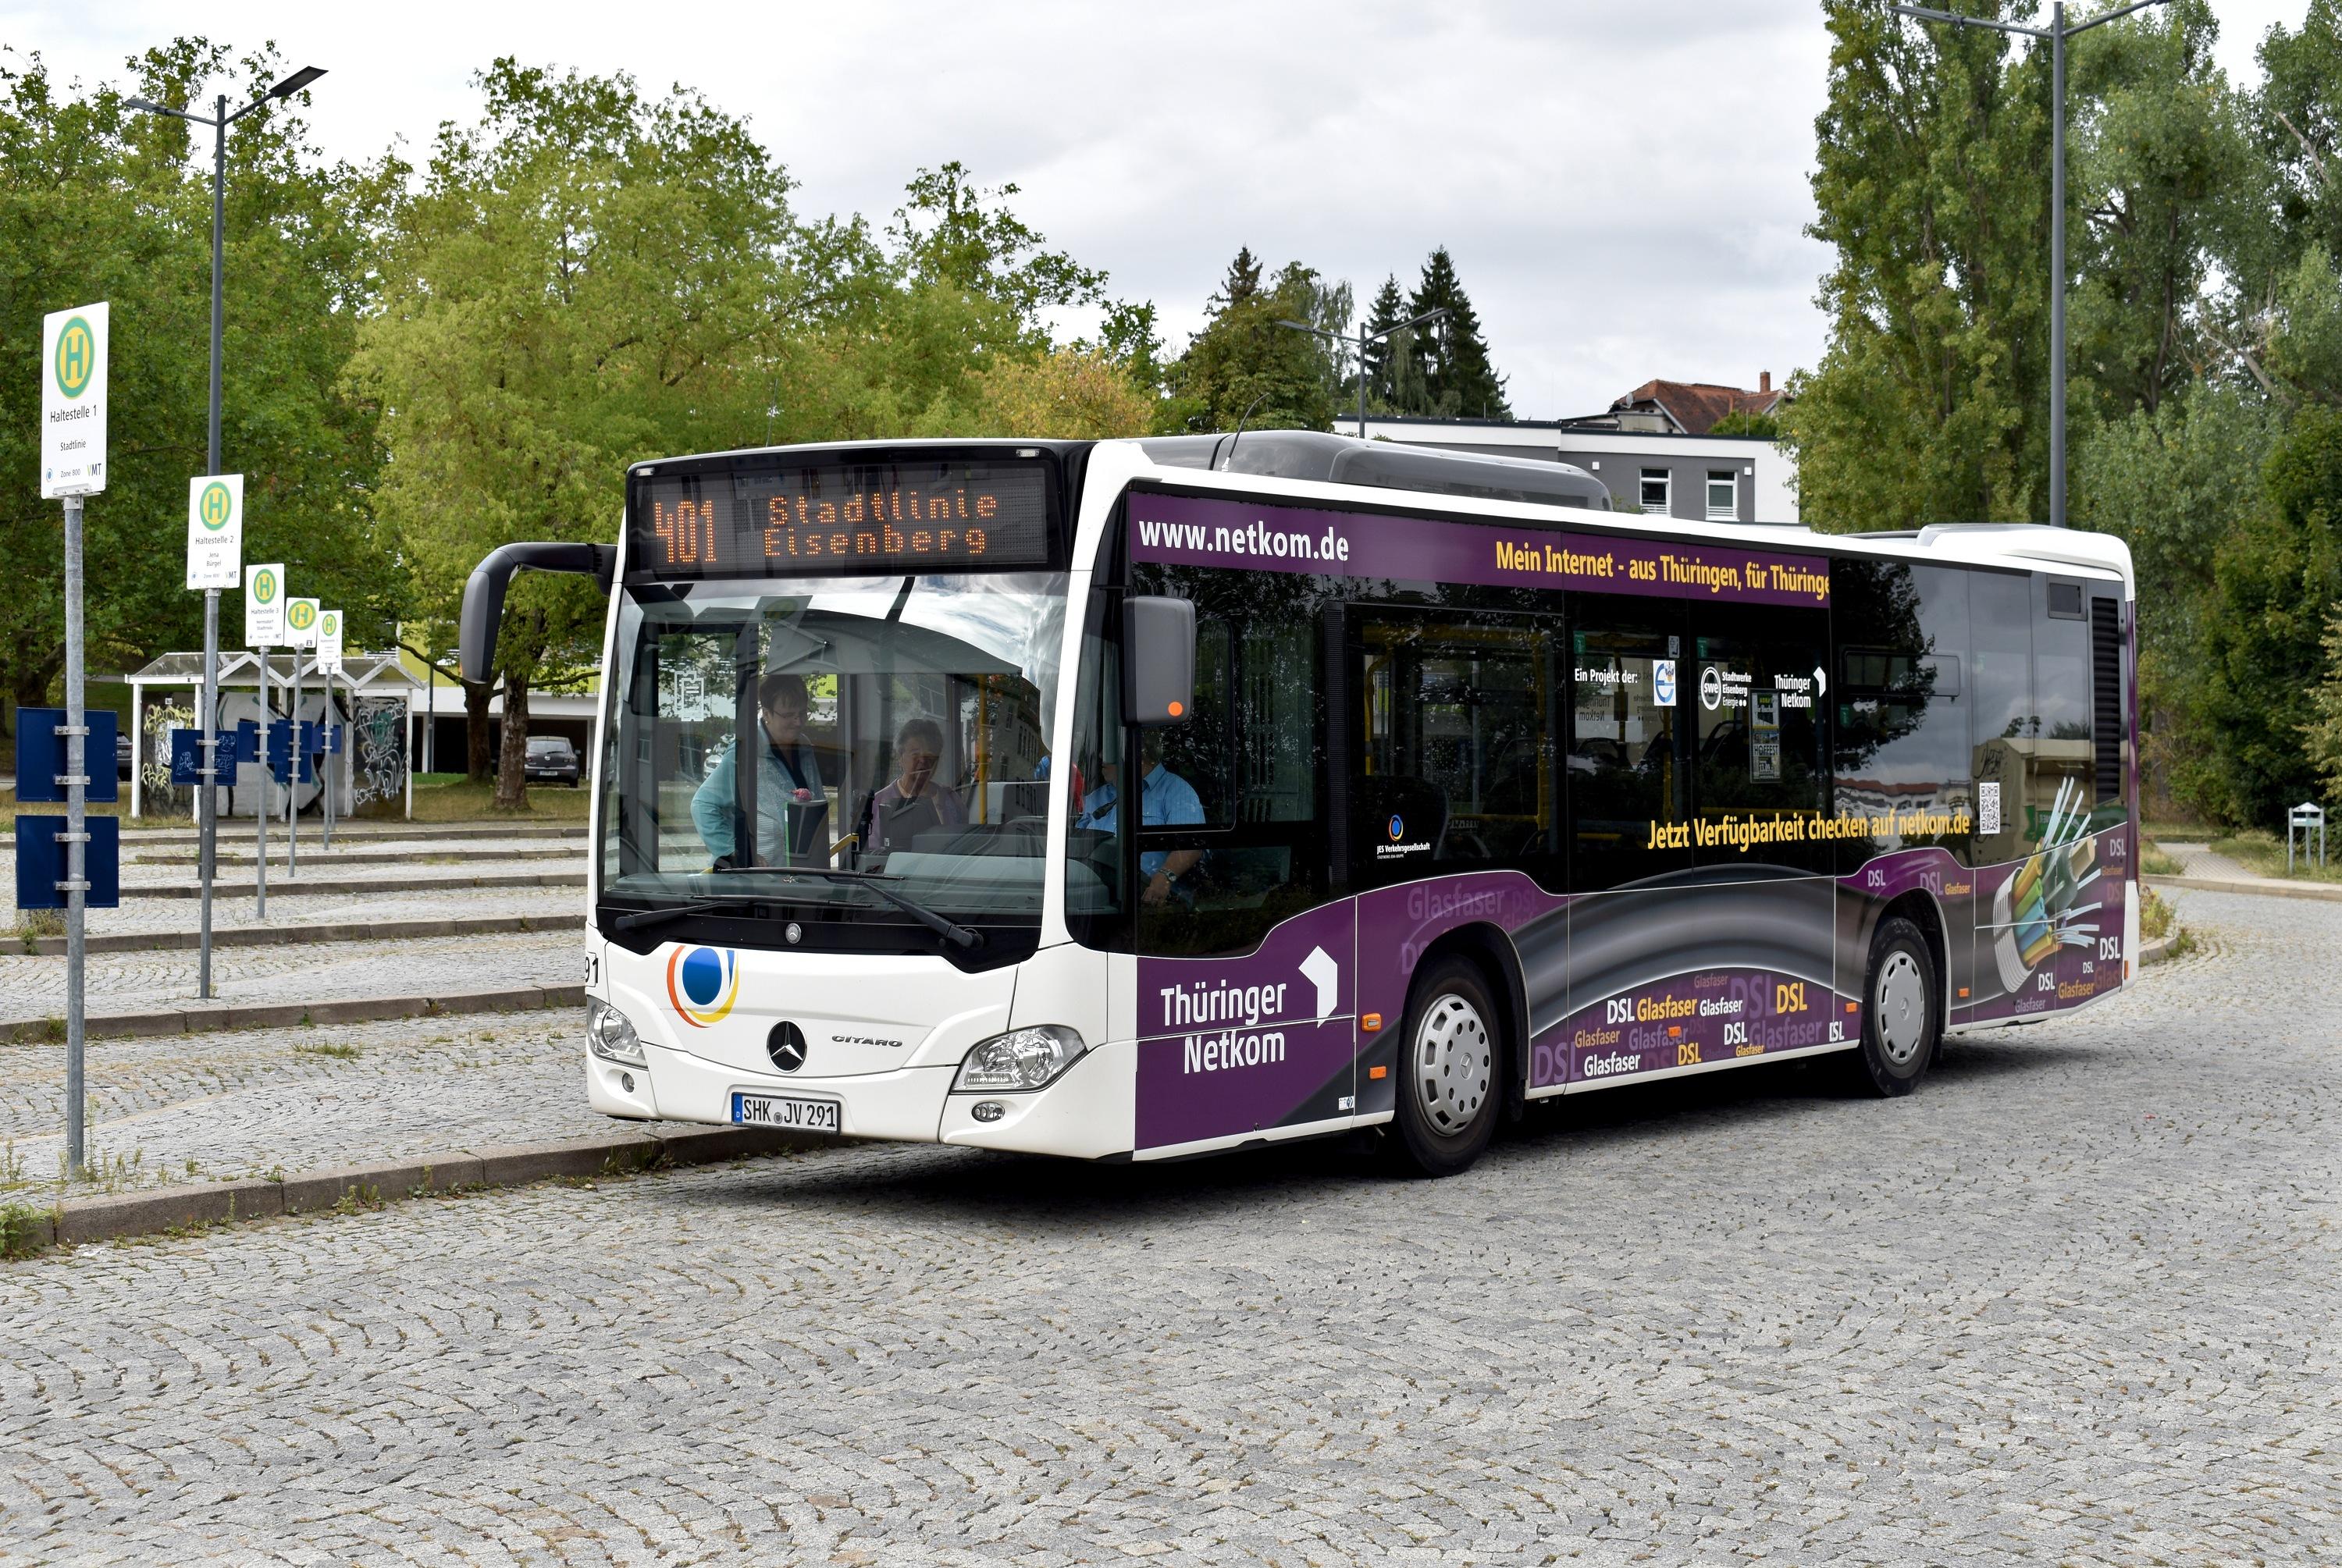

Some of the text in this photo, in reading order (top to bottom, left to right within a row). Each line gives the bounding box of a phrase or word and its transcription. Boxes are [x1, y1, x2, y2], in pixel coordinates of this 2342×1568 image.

[65, 334, 84, 381] H
[50, 404, 97, 424] Haltestelle 1
[60, 439, 87, 452] Stadtlinie
[72, 468, 81, 477] 800
[87, 463, 101, 477] VMT
[208, 492, 222, 521] H
[655, 489, 997, 563] 401 Stadtlinie
[195, 535, 228, 545] Haltestelle
[764, 524, 986, 556] Eisenberg
[1138, 520, 1349, 562] www.netkom.de
[206, 559, 222, 568] Bürgel
[1496, 540, 1541, 572] Mein
[1545, 545, 1614, 578] Internet
[1629, 559, 1657, 581] aus
[1659, 555, 1742, 593] Thüringen,
[1746, 561, 1767, 590] für
[259, 577, 270, 596] H
[295, 606, 308, 624] H
[1574, 667, 1588, 681] Ein
[1590, 668, 1620, 686] Projekt
[1621, 669, 1638, 684] der:
[1721, 671, 1752, 683] Stadtwerke
[1774, 674, 1811, 693] Thüringer
[1703, 682, 1718, 694] swe
[1722, 684, 1748, 697] Eisenberg
[1722, 697, 1739, 709] Energie
[1781, 692, 1811, 708] Netkom
[1647, 806, 1970, 853] Jetzt Verfügbarkeit checken auf netkom.de
[1385, 841, 1431, 854] Verkehrsgesellschaft
[2109, 838, 2127, 857] DSL
[1868, 869, 1886, 887] DSL
[2102, 864, 2124, 876] Glasfaser
[1920, 871, 1944, 896] DSL
[1945, 882, 1971, 896] Glasfaser
[1407, 883, 1506, 920] Glasfaser
[2099, 936, 2121, 961] DSL
[2083, 961, 2094, 974] DSL
[1694, 972, 1728, 989] Glasfaser
[2038, 972, 2055, 992] DSL
[2058, 980, 2095, 1000] Glasfaser
[1160, 979, 1287, 1026] Thüringer
[1777, 982, 1808, 1014] DSL
[2015, 997, 2046, 1014] Glasfaser
[1607, 997, 1635, 1025] DSL
[1636, 994, 1698, 1022] Glasfaser
[1700, 996, 1743, 1017] Glasfaser
[831, 1035, 903, 1047] CITARO
[1575, 1027, 1621, 1049] Glasfaser
[1724, 1021, 1748, 1046] DSL
[1749, 1015, 1823, 1050] Glasfaser
[1183, 1029, 1285, 1074] Netkom
[1678, 1042, 1702, 1066] DSL
[1735, 1043, 1766, 1058] Glasfaser
[1534, 1041, 1582, 1086] DSL
[1584, 1051, 1641, 1077] Glasfaser
[743, 1099, 836, 1127] SHK JV 291
